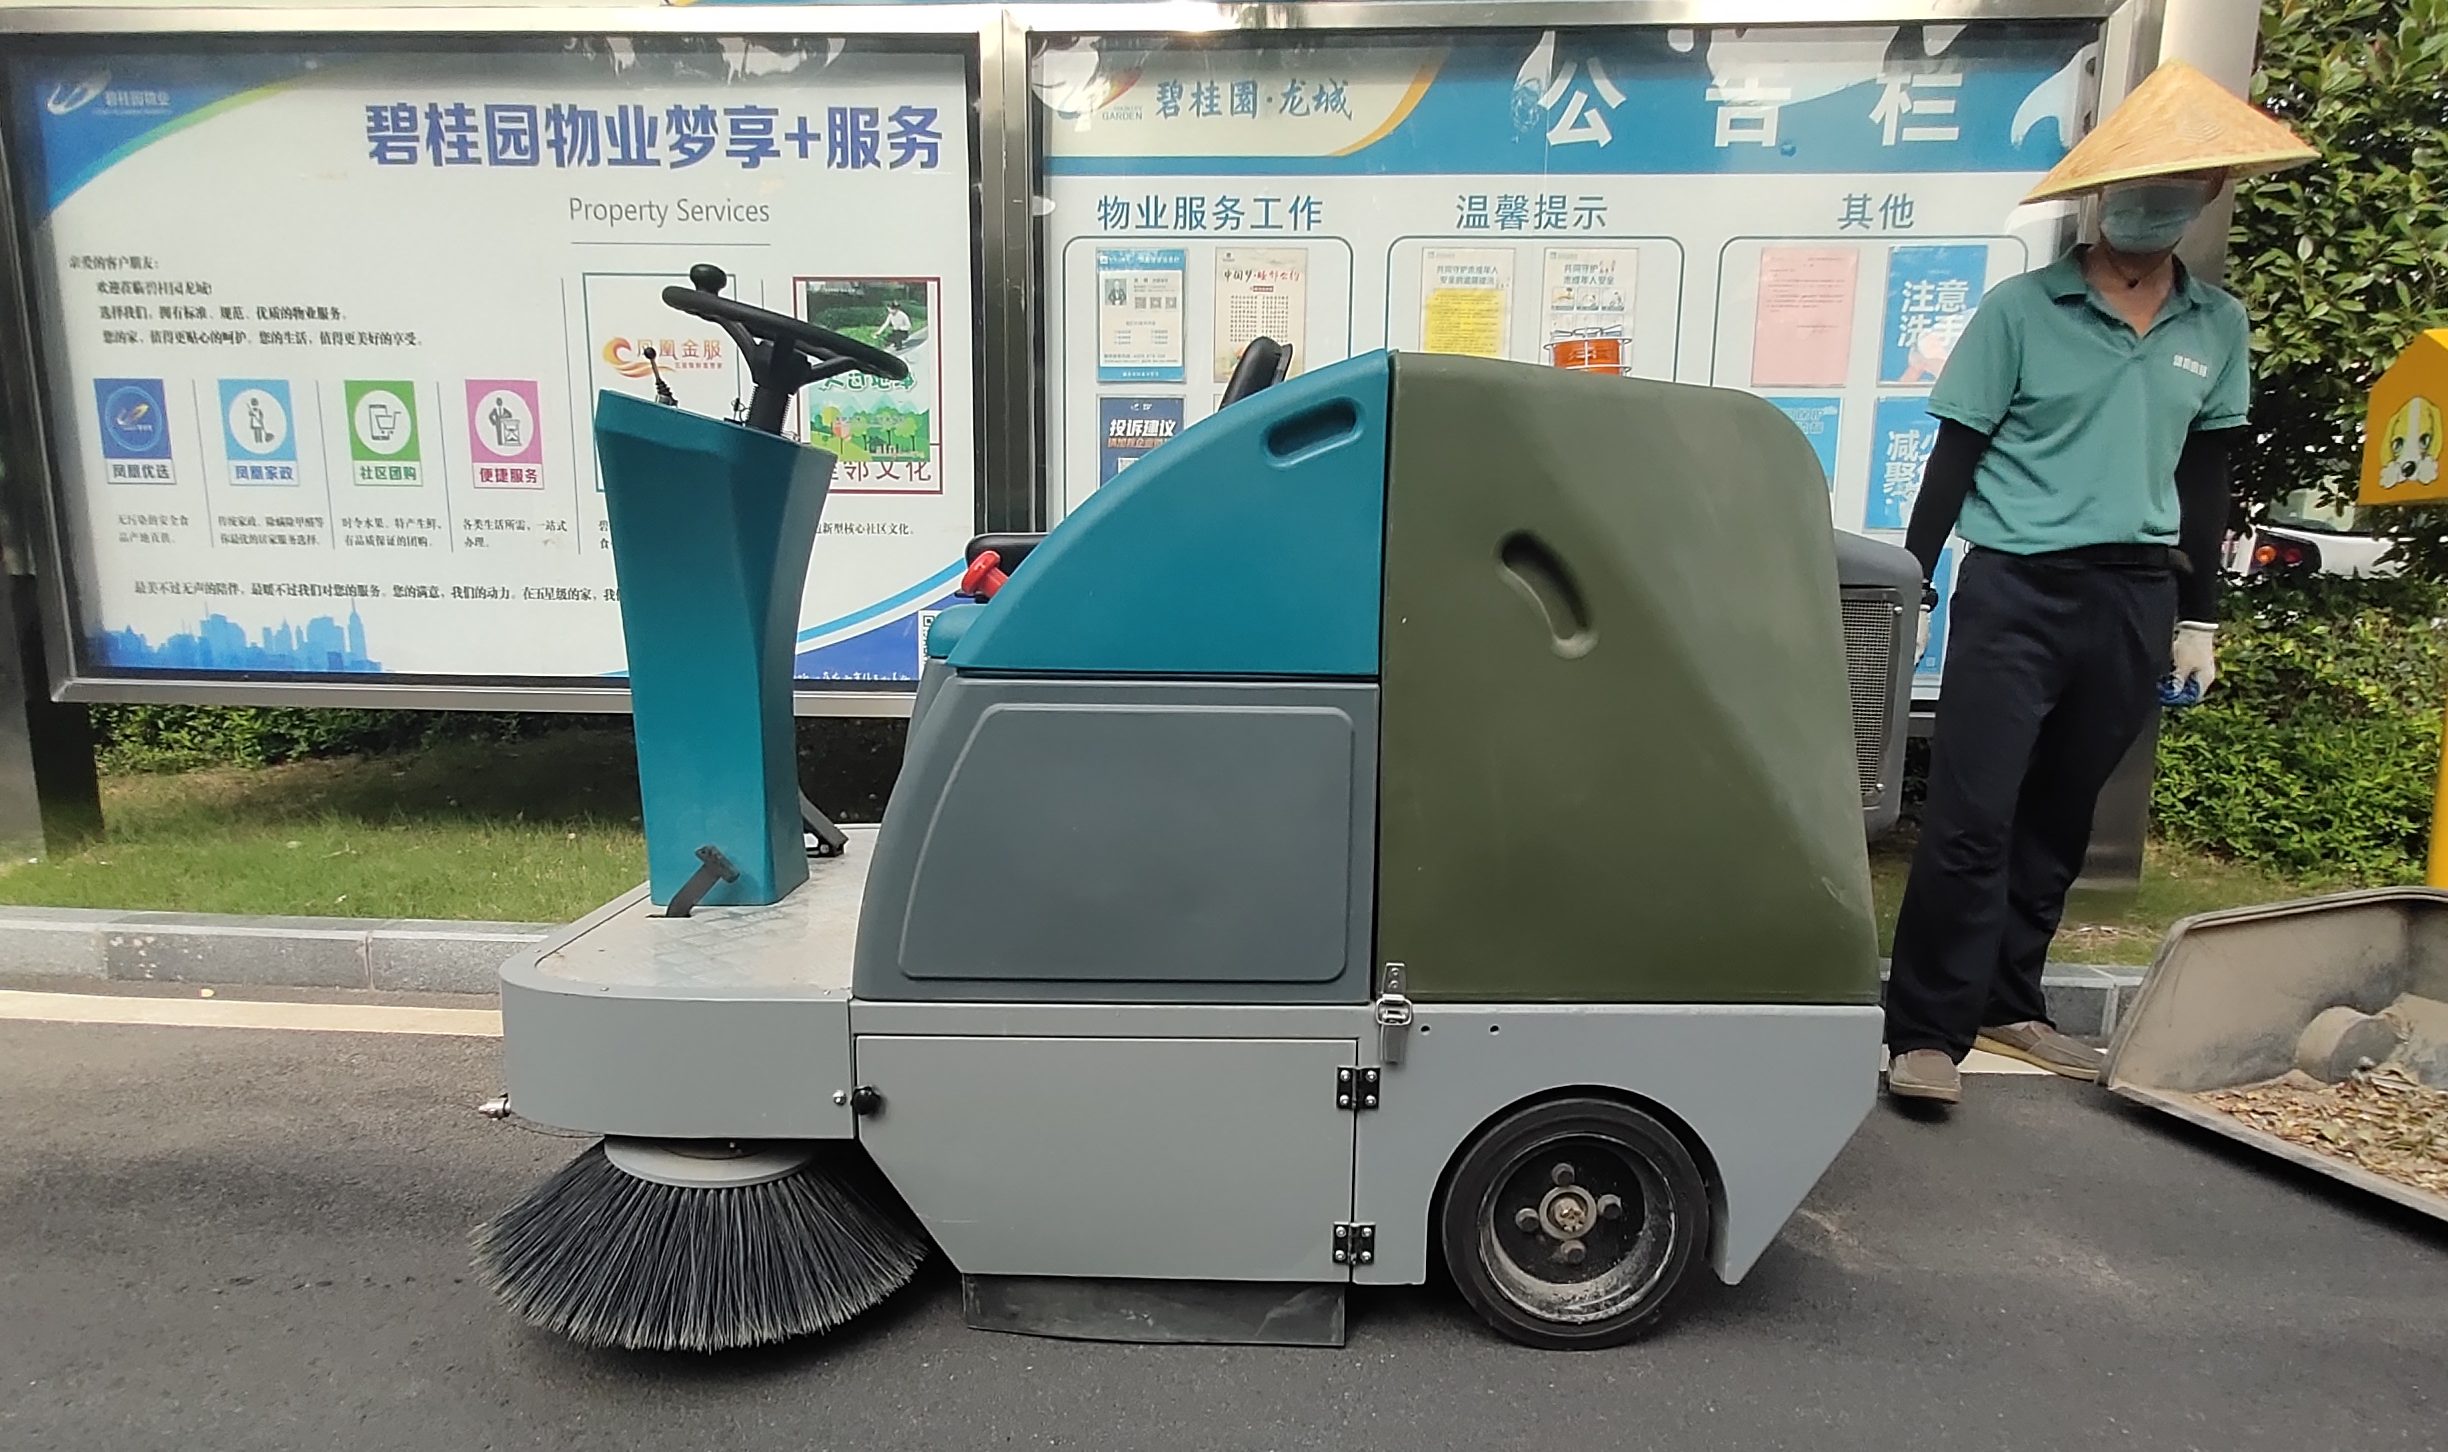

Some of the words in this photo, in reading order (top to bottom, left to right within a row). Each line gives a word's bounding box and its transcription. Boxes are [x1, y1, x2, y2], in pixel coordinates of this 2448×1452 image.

[1538, 56, 1963, 149] 公告栏
[1102, 111, 1144, 121] GARDEN
[365, 102, 943, 170] 碧桂园物业梦享+服务
[569, 197, 669, 228] Property
[676, 198, 770, 223] Services
[1097, 194, 1324, 232] 物业服务工作
[1455, 193, 1609, 231] 温馨提示
[1837, 193, 1915, 230] 其他
[1901, 279, 1970, 313] 注意
[1109, 419, 1176, 437] 投诉建议
[112, 463, 171, 480] 凤凰优选
[235, 465, 294, 482] 凤凰家政
[359, 465, 417, 481] 社区团购
[480, 467, 538, 484] 便捷服务
[831, 461, 931, 482] 邻文化
